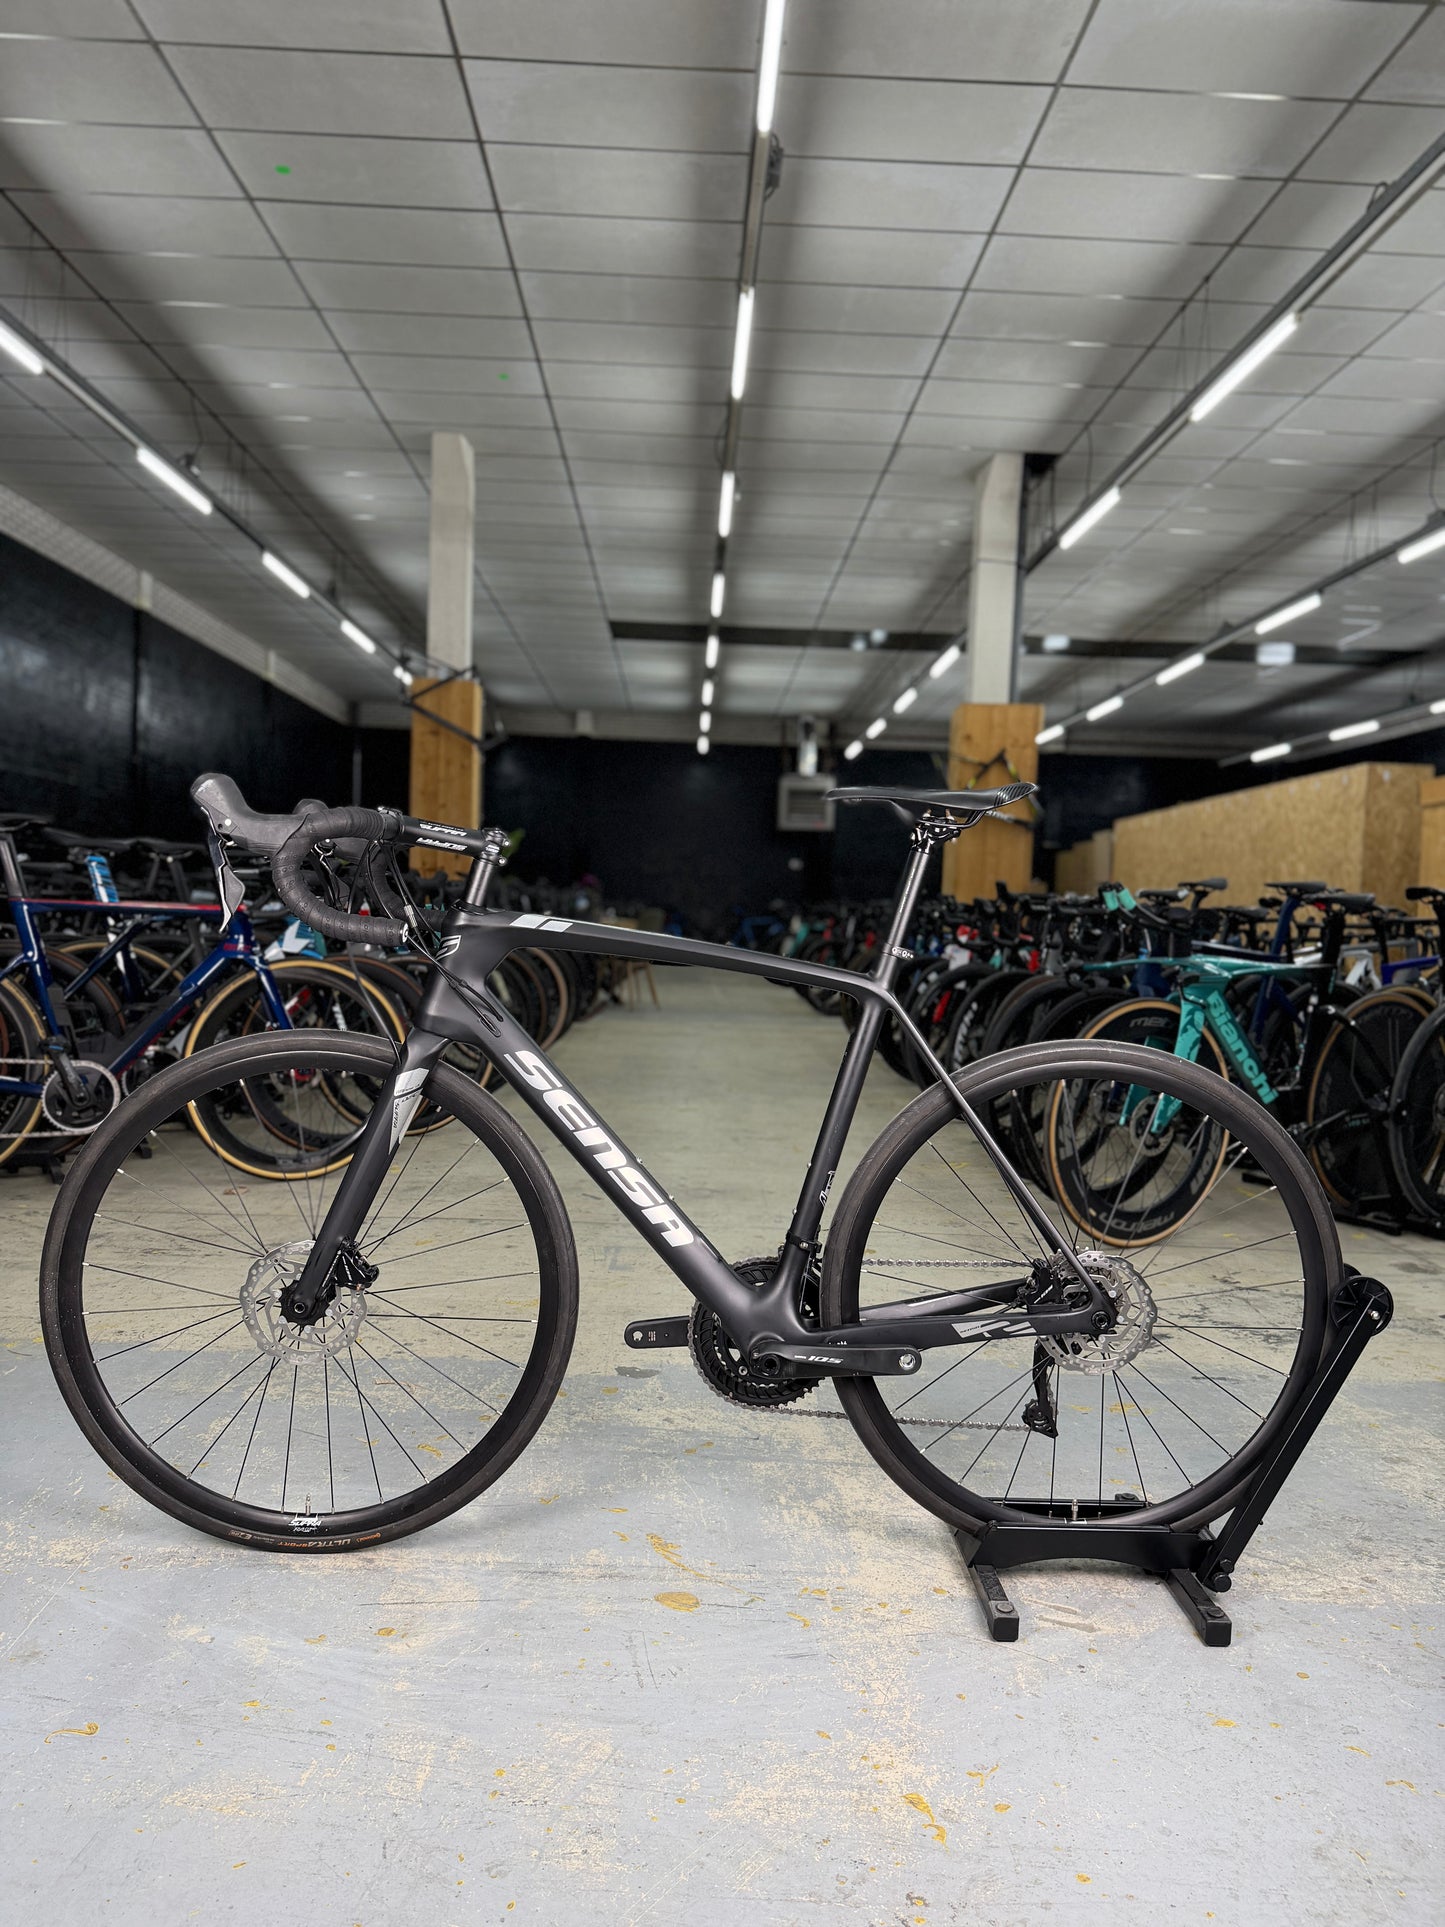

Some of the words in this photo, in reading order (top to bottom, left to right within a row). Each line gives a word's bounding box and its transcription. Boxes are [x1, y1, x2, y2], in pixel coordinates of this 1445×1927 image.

[1206, 990, 1279, 1105] Bianchi
[808, 1354, 843, 1364] 105
[308, 1538, 351, 1548] ULTRA
